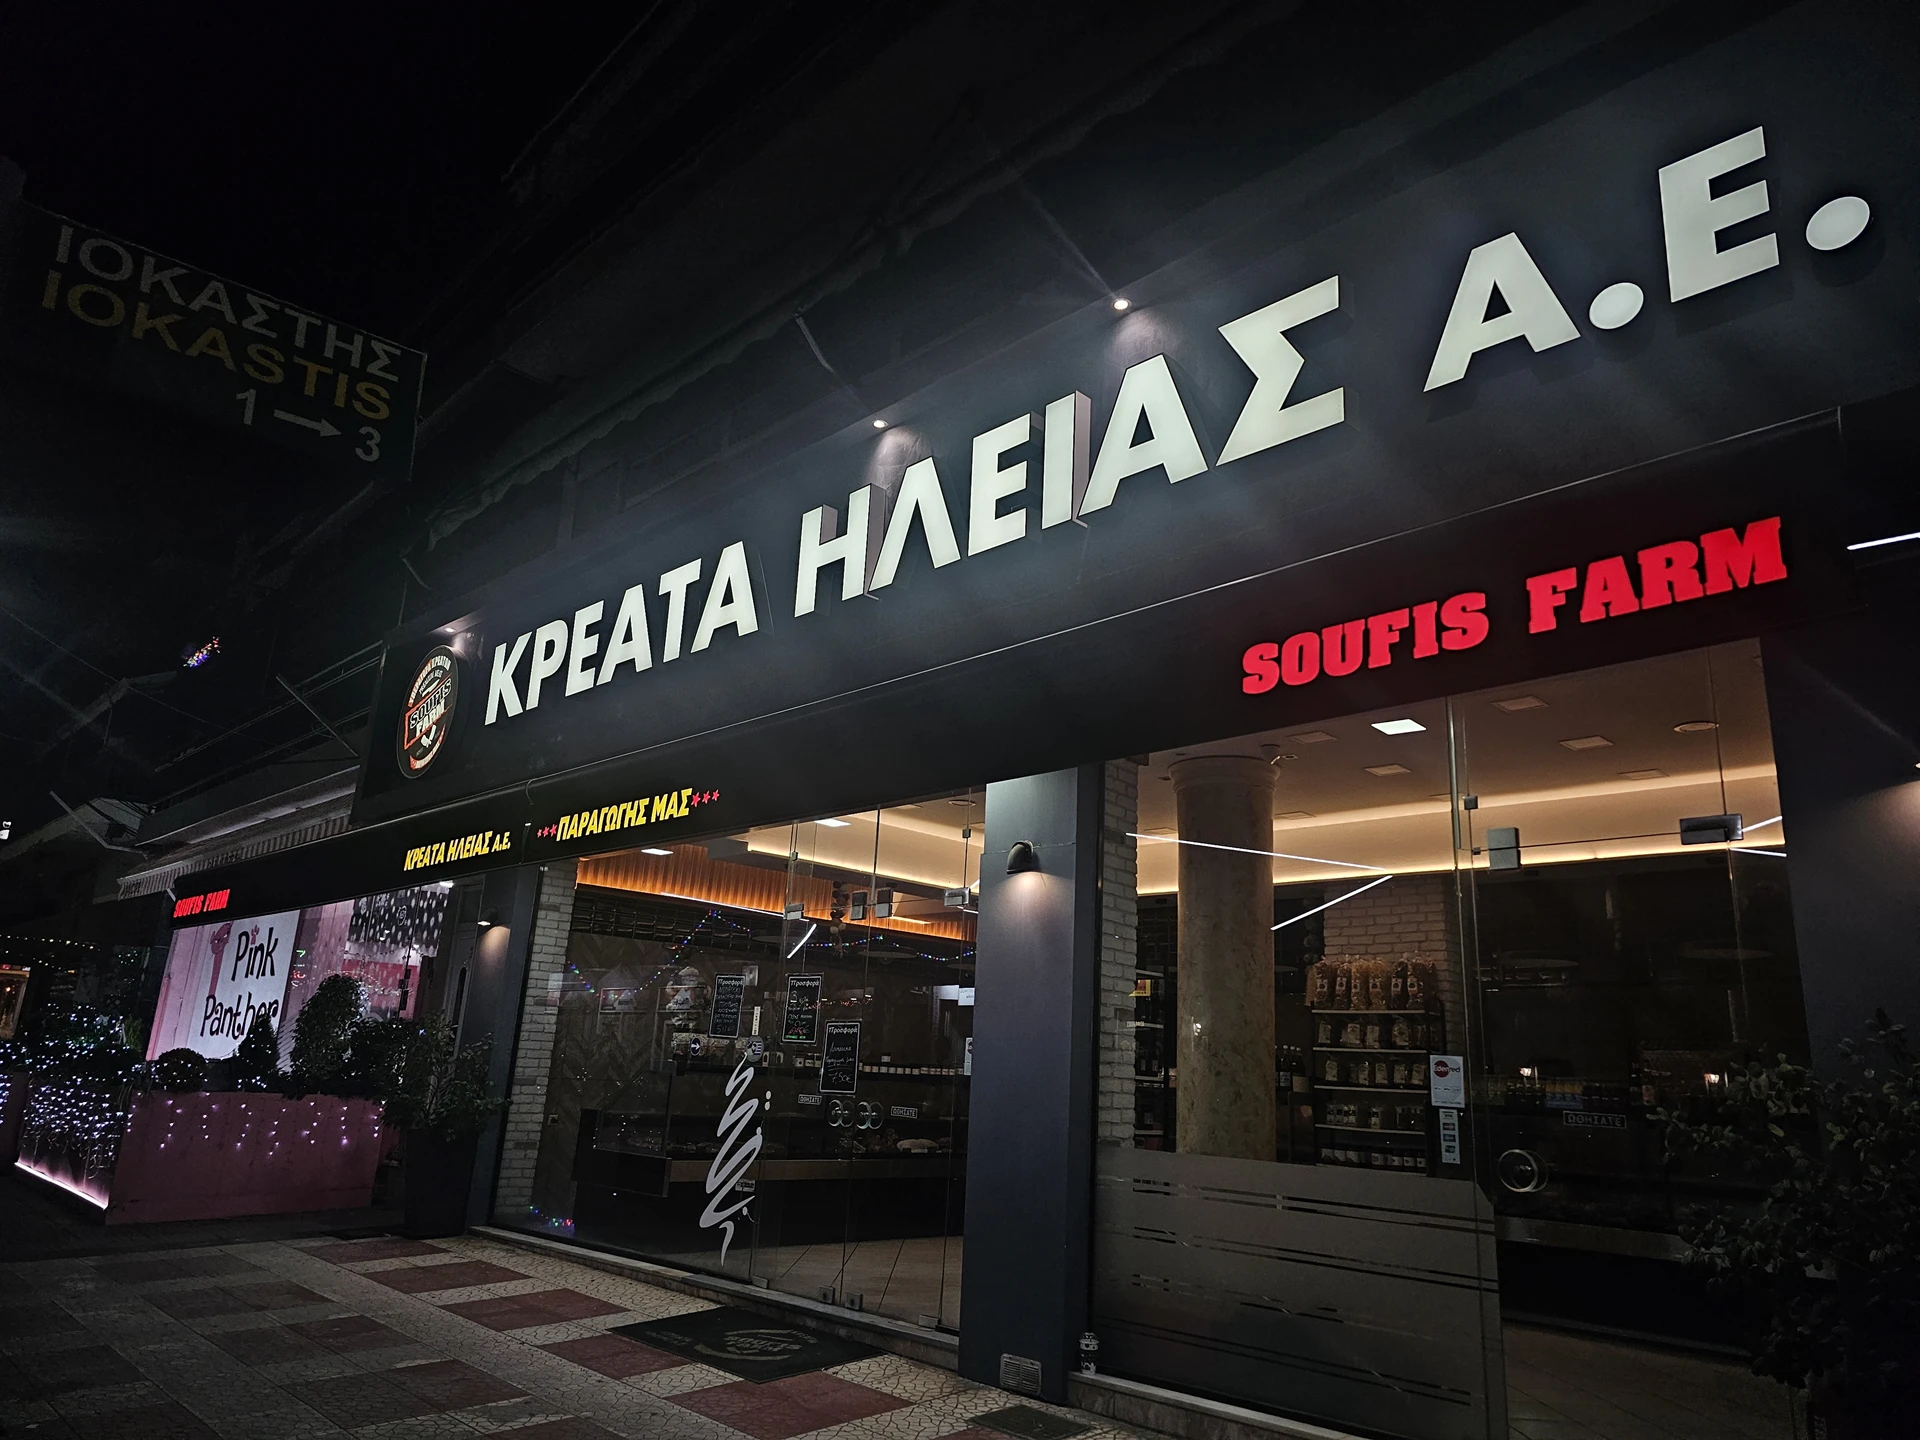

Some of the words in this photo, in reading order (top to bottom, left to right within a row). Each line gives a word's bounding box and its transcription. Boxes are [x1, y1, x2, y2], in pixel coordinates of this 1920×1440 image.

[56, 224, 401, 382] ΙΟΚΑΣΤΗΣ
[41, 270, 391, 420] IOKASTIS
[235, 388, 257, 426] 1
[485, 541, 758, 726] ΚΡΕΑΤΑ
[795, 275, 1345, 618] ΗΛΕΙΑΣ
[1423, 126, 1871, 392] Α.Ε.
[355, 426, 381, 463] 3
[1242, 592, 1489, 694] SOUFIS
[1526, 516, 1787, 634] FARM
[410, 678, 452, 729] SOUFIS
[416, 701, 446, 737] FARM
[556, 798, 649, 841] ΠΑΡΑΓΩΓΗΣ
[651, 788, 692, 823] ΜΑΣ
[403, 845, 445, 871] ΚΡΕΑΤΑ
[447, 831, 492, 863] ΗΛΕΙΑΣ
[173, 895, 203, 918] SOUFIS
[203, 889, 231, 912] FARM
[231, 926, 279, 981] Pink
[1434, 1065, 1461, 1073] Edenred
